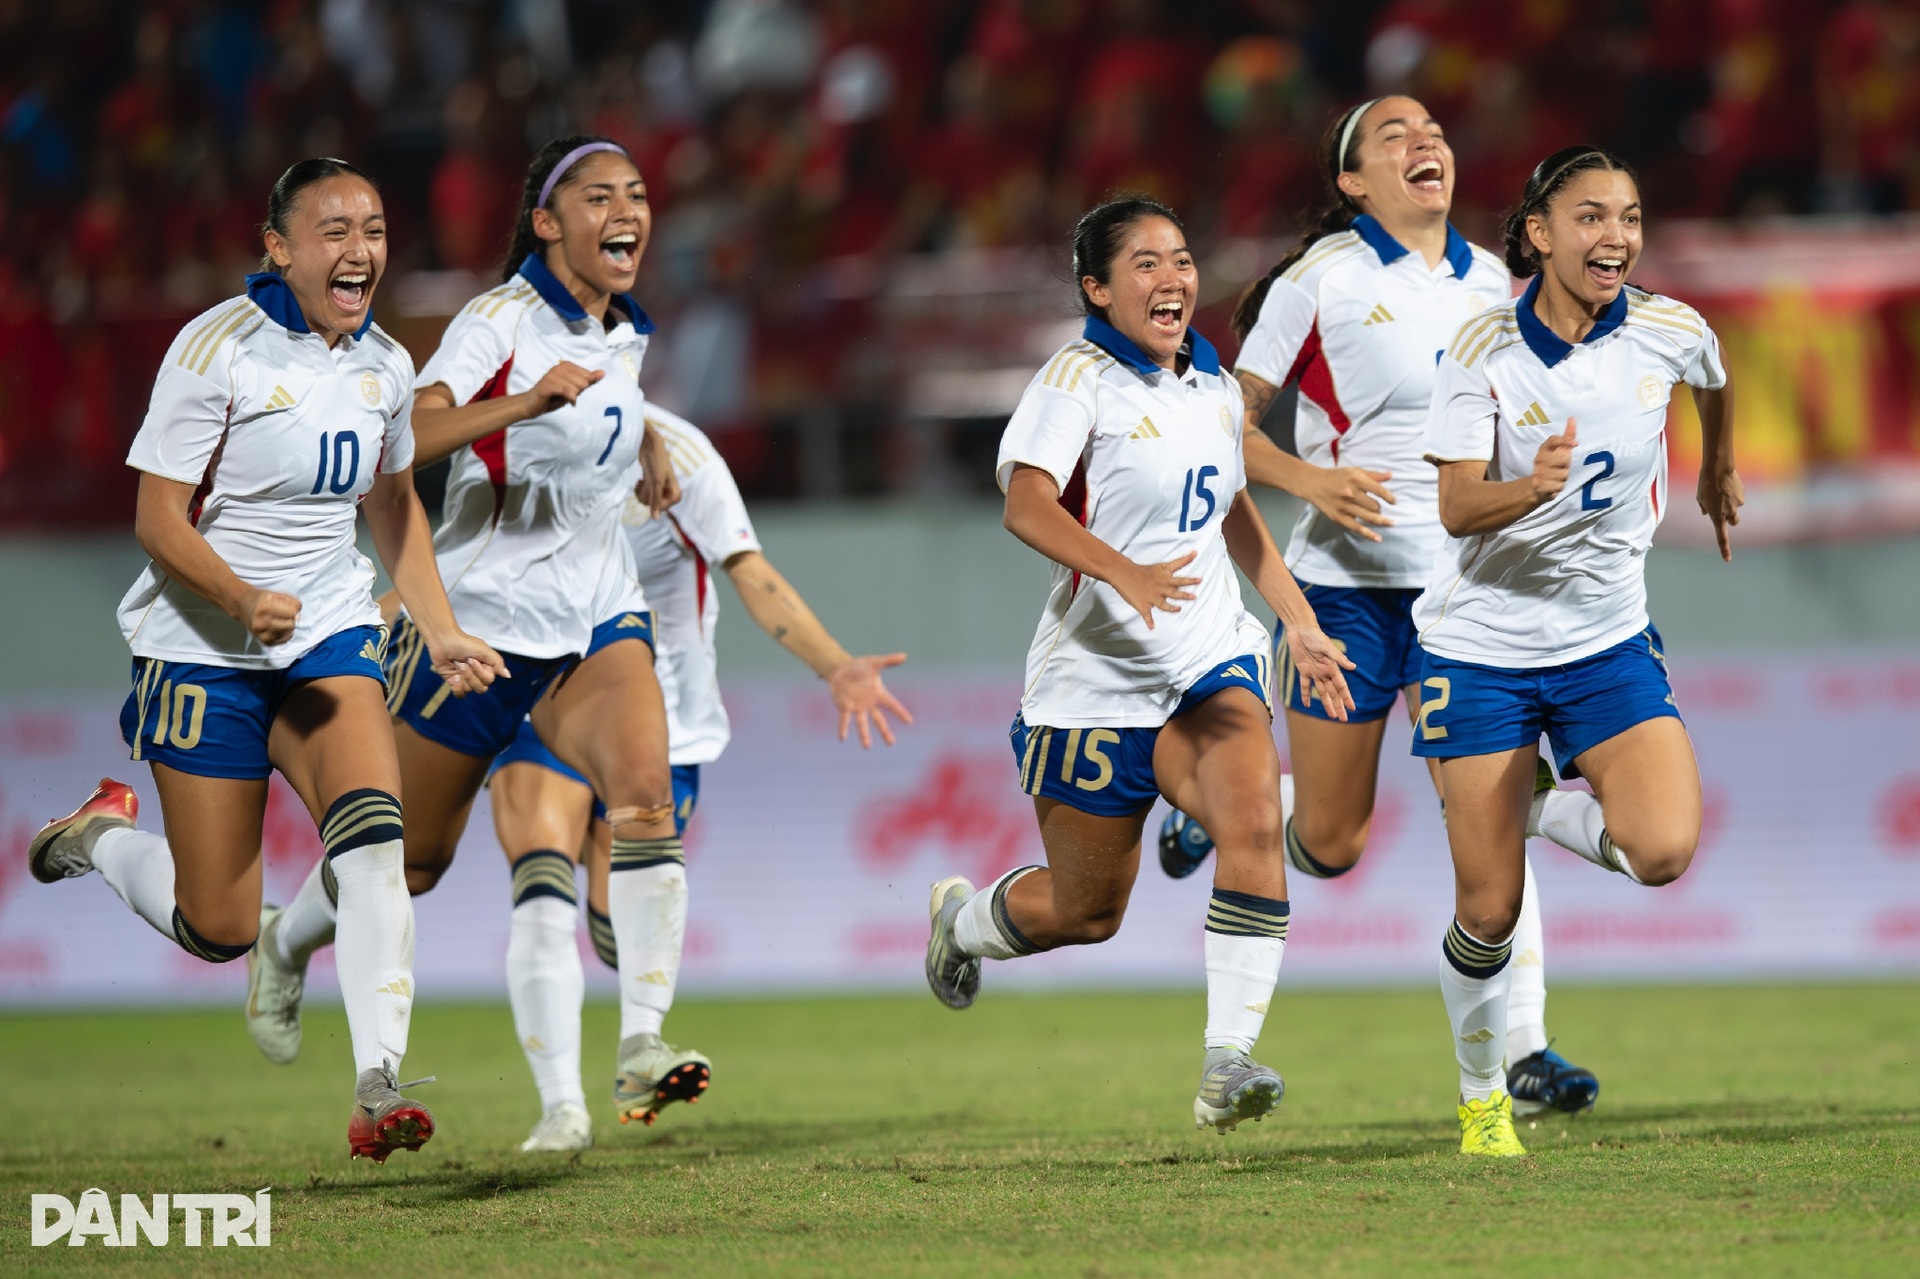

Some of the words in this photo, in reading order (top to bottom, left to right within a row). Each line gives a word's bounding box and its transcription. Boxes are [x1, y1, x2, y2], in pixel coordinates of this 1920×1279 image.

[311, 430, 360, 495] 10
[597, 406, 622, 466] 7
[1178, 465, 1219, 533] 15
[1582, 450, 1615, 512] 2
[152, 678, 207, 750] 10
[1420, 676, 1451, 740] 2
[1061, 728, 1120, 791] 15
